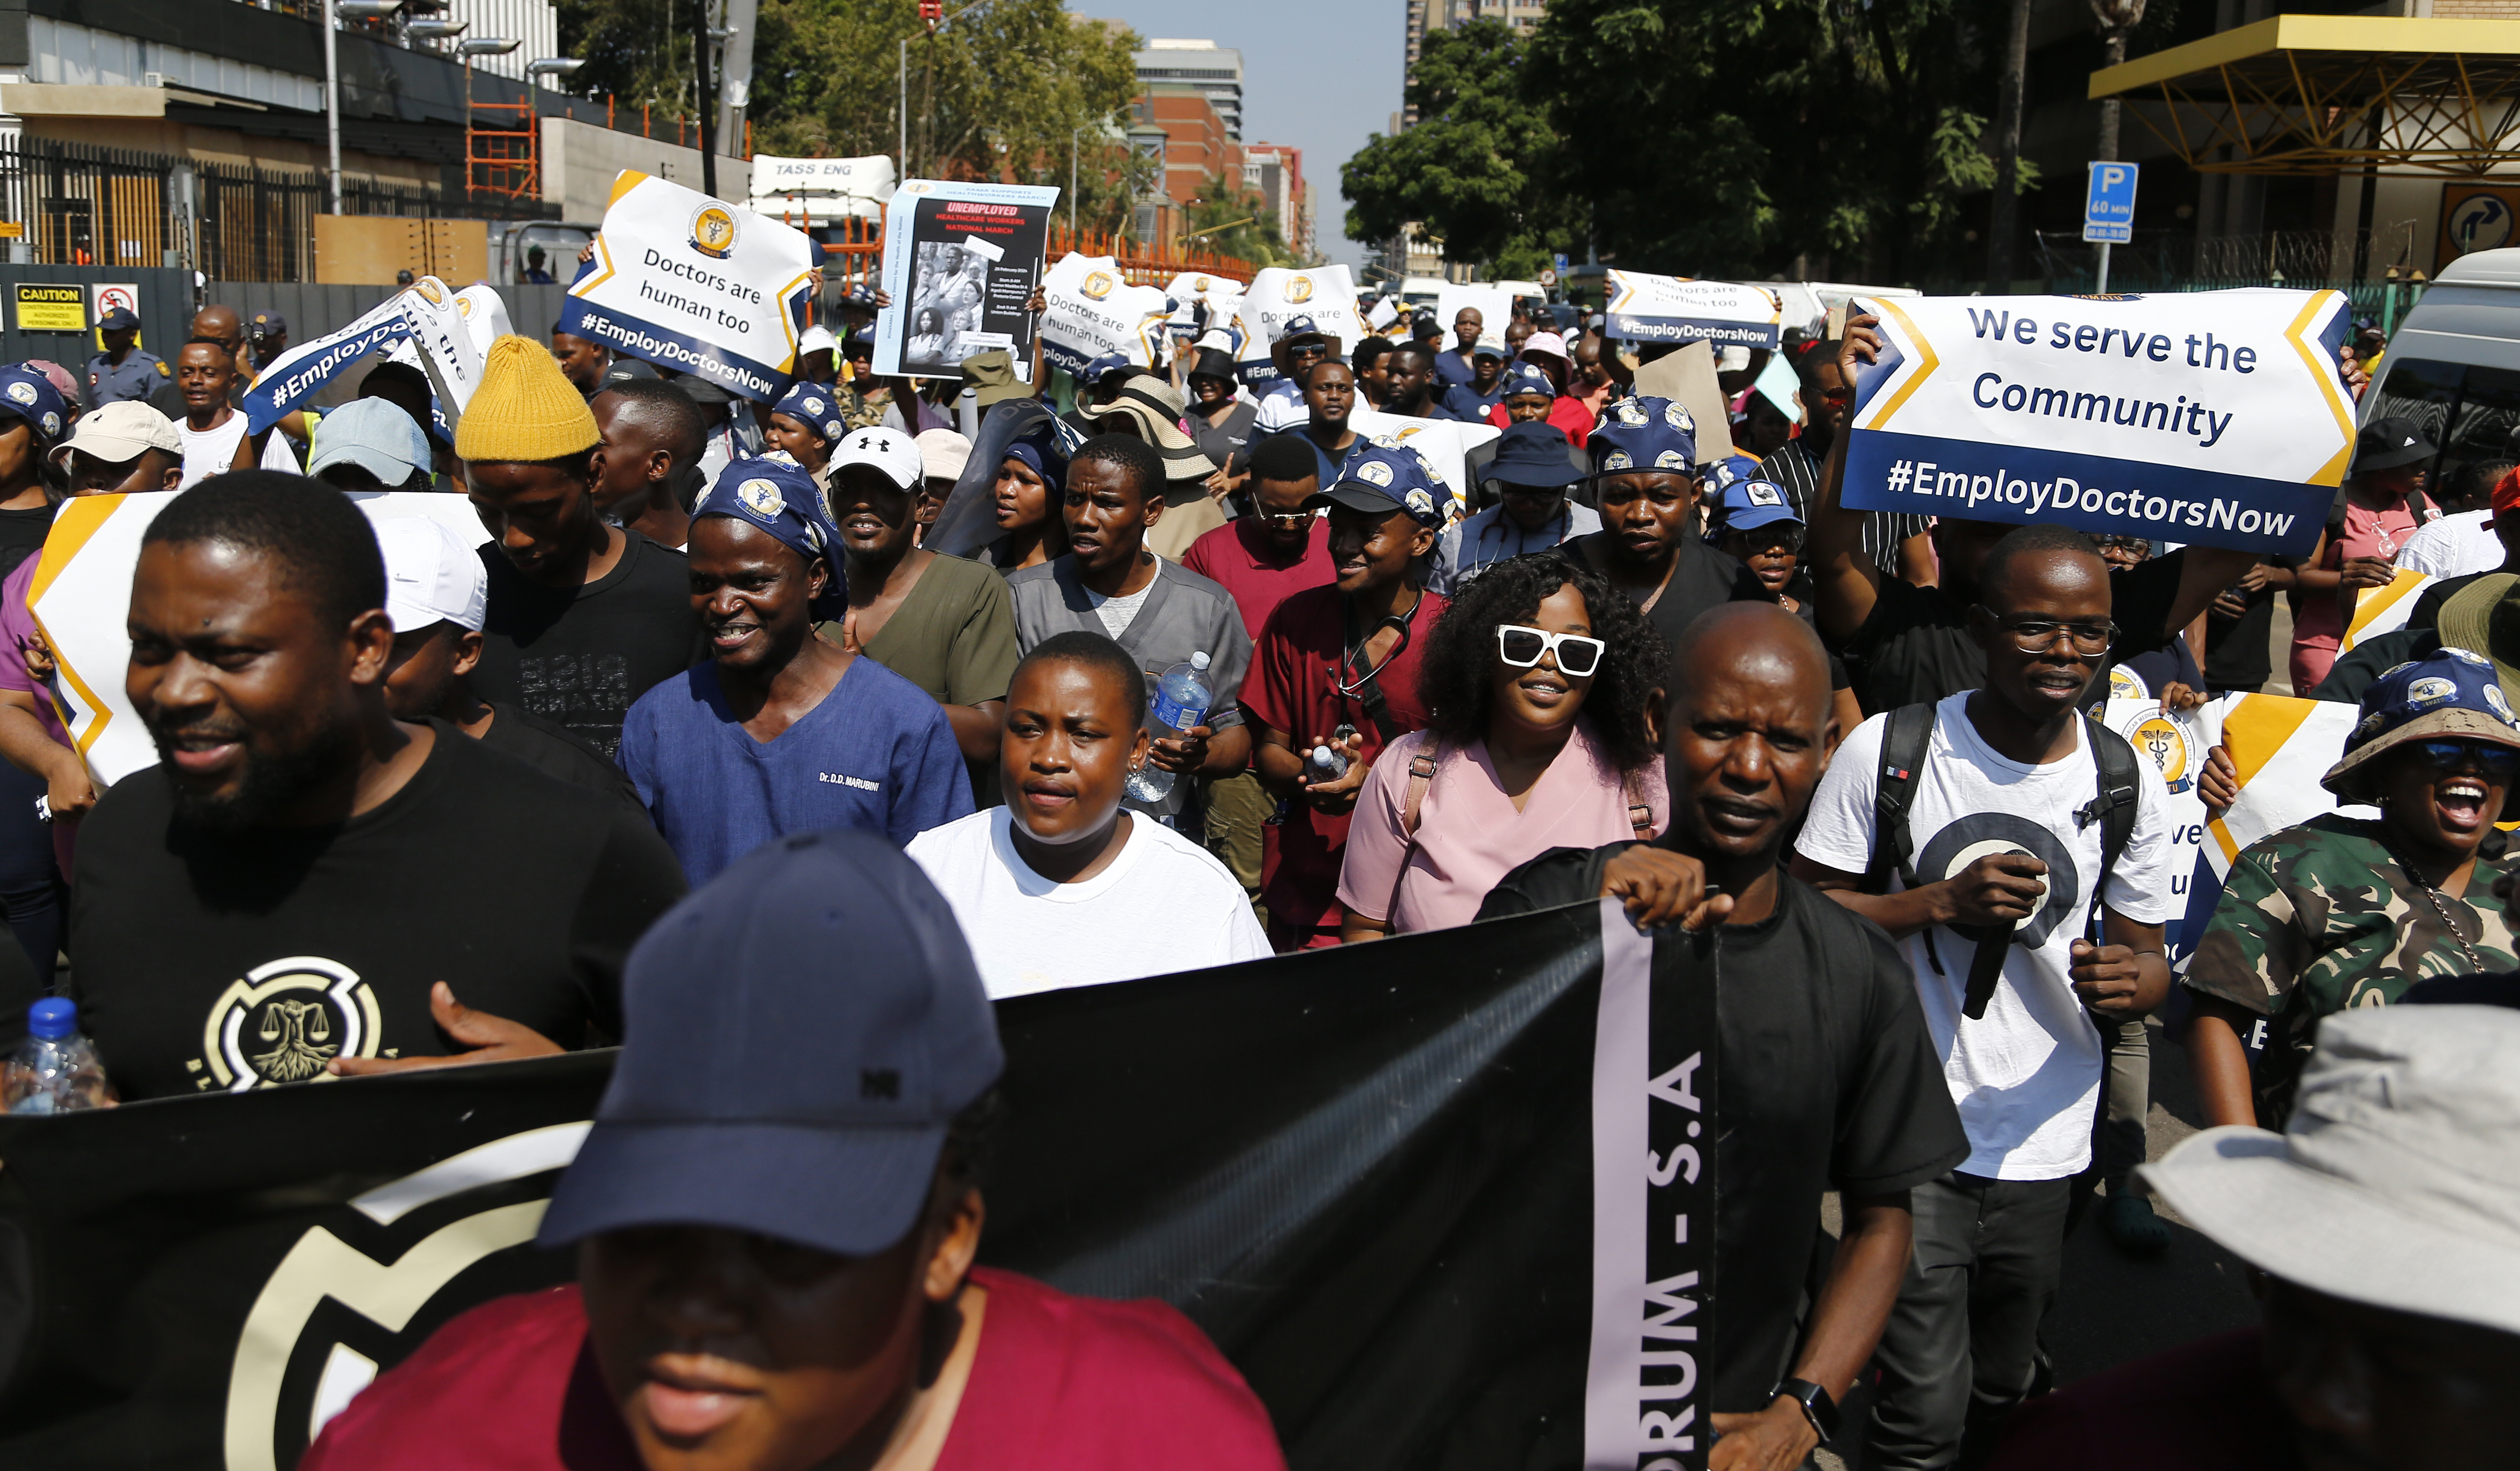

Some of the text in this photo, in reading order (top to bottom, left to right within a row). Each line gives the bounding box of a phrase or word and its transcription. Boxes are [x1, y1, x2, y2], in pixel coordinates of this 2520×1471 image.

[776, 164, 852, 175] TASS ENG
[2101, 167, 2125, 193] P
[936, 213, 1026, 225] HEALTHCARE WORKERS
[947, 202, 1018, 216] UNEMPLOYED
[2091, 200, 2130, 215] 60 MIN
[945, 224, 983, 232] NATIONAL
[643, 248, 761, 305] Doctors are
[1650, 278, 1708, 294] Doctors
[20, 288, 79, 301] CAUTION
[639, 279, 750, 334] human too
[1050, 294, 1124, 332] Doctors are
[1261, 310, 1341, 323] Doctors are
[1048, 315, 1115, 351] human too
[1623, 320, 1768, 343] #EmployDoctorsNow
[1967, 307, 2257, 374] We serve the
[581, 313, 774, 396] #EmployDoctorsNow
[1042, 346, 1084, 370] ployDo
[1973, 372, 2234, 448] Community
[1887, 459, 2295, 538] #EmployDoctorsNow
[745, 505, 766, 520] SAMATU
[820, 503, 834, 523] SAMATU
[2125, 720, 2138, 740] AFRICAN
[2139, 711, 2156, 722] MEDICAL
[2180, 727, 2190, 743] TRADE
[819, 772, 880, 792] Dr. D.D. MARUBINI
[1647, 1051, 1701, 1187] S.A
[1639, 1270, 1699, 1471] RUM
